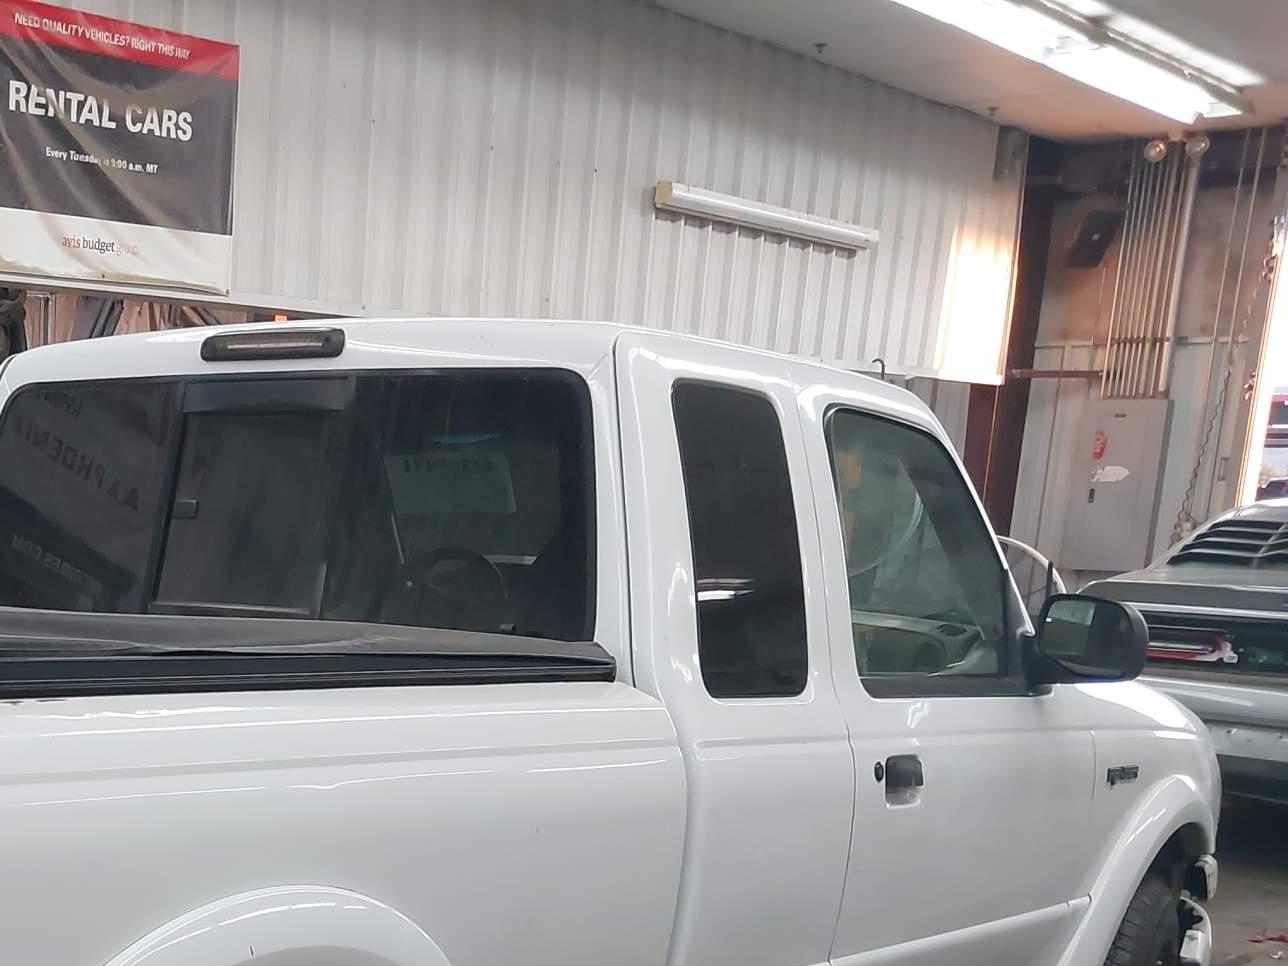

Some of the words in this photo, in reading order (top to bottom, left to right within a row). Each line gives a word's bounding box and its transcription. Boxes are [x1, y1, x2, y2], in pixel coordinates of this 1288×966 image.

[14, 12, 40, 28] NEED
[42, 18, 84, 37] QUALITY
[84, 28, 130, 47] VEHICLES?
[131, 37, 156, 53] RIGHT
[157, 43, 175, 57] THIS
[175, 47, 192, 60] WAY
[9, 79, 116, 130] RENTAL
[125, 104, 193, 142] CARS
[45, 146, 68, 161] Every
[128, 162, 145, 173] a.m.
[145, 163, 159, 174] MT
[62, 234, 81, 249] avis
[82, 236, 115, 254] budget
